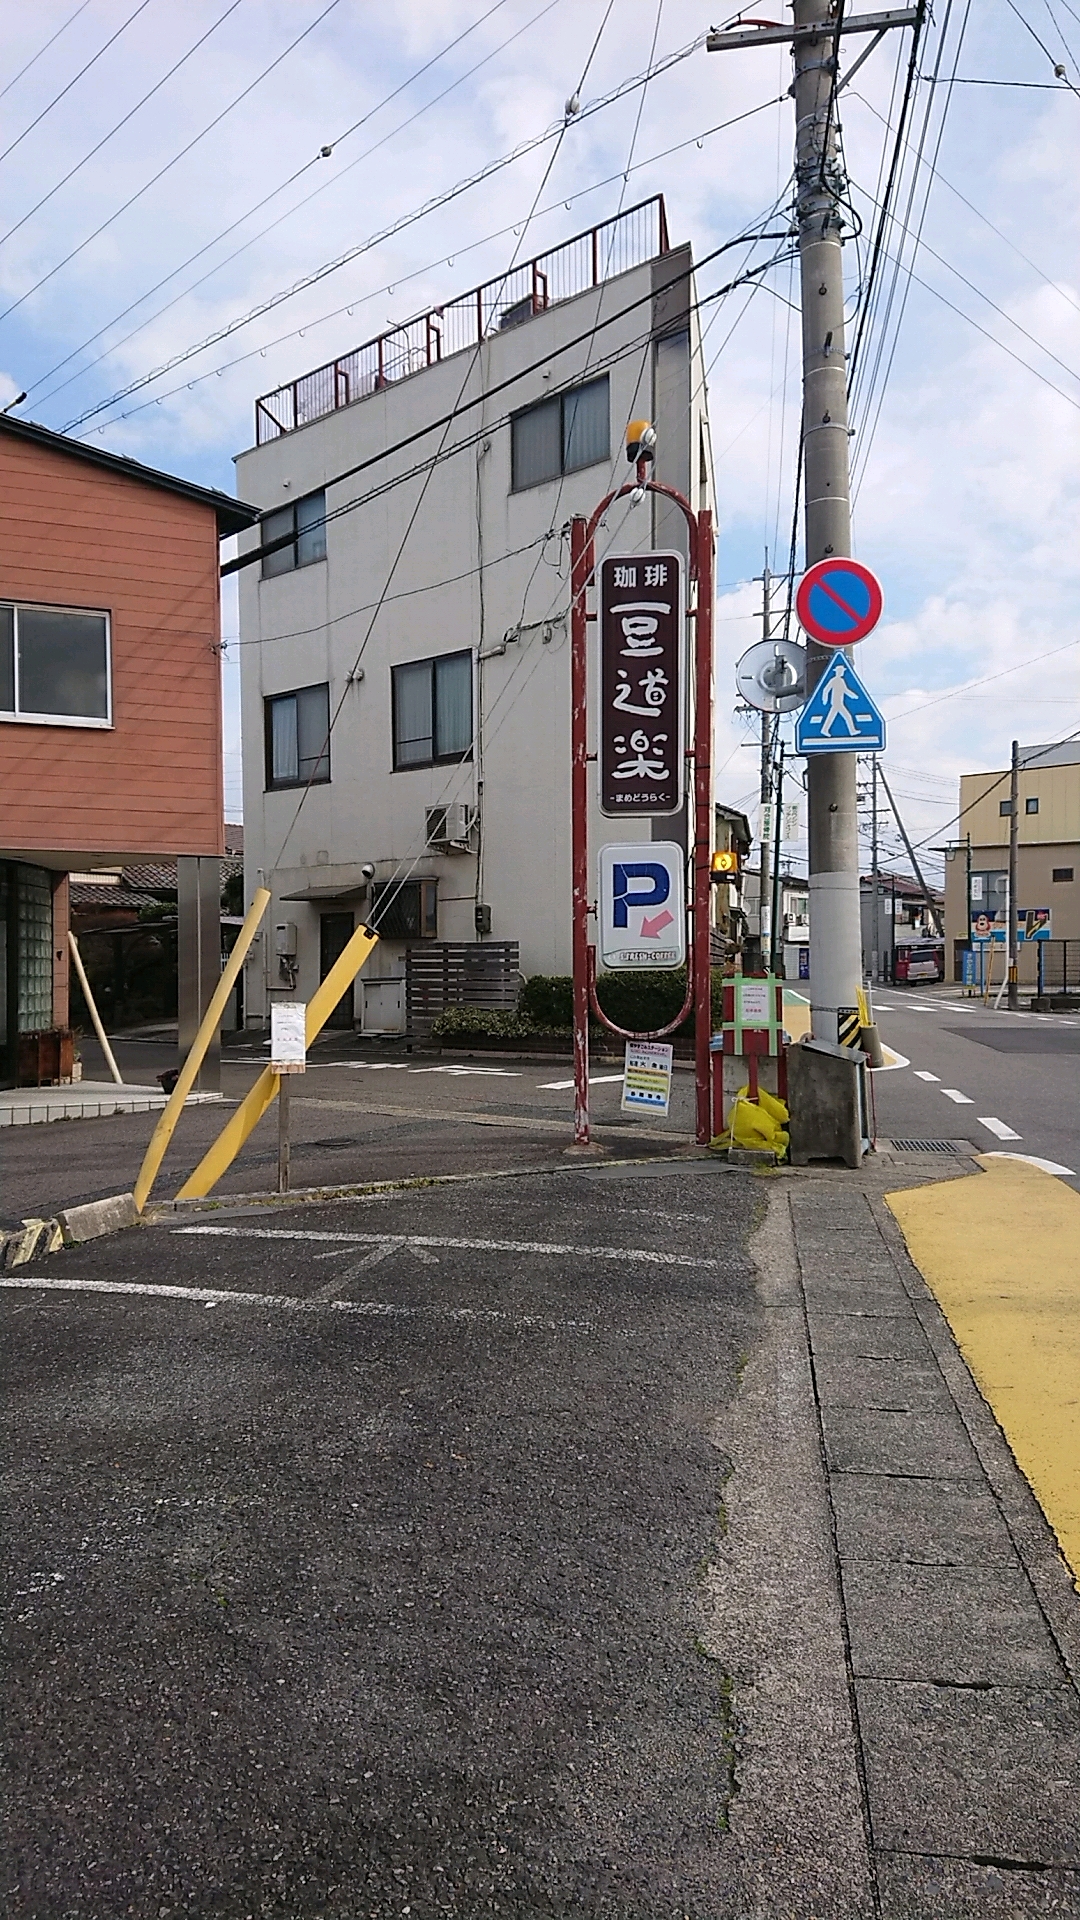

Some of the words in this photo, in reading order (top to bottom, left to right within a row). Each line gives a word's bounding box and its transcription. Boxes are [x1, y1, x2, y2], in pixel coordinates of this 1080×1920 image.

[613, 564, 668, 588] 珈琲
[609, 601, 672, 781] 豆道楽
[612, 863, 670, 928] P
